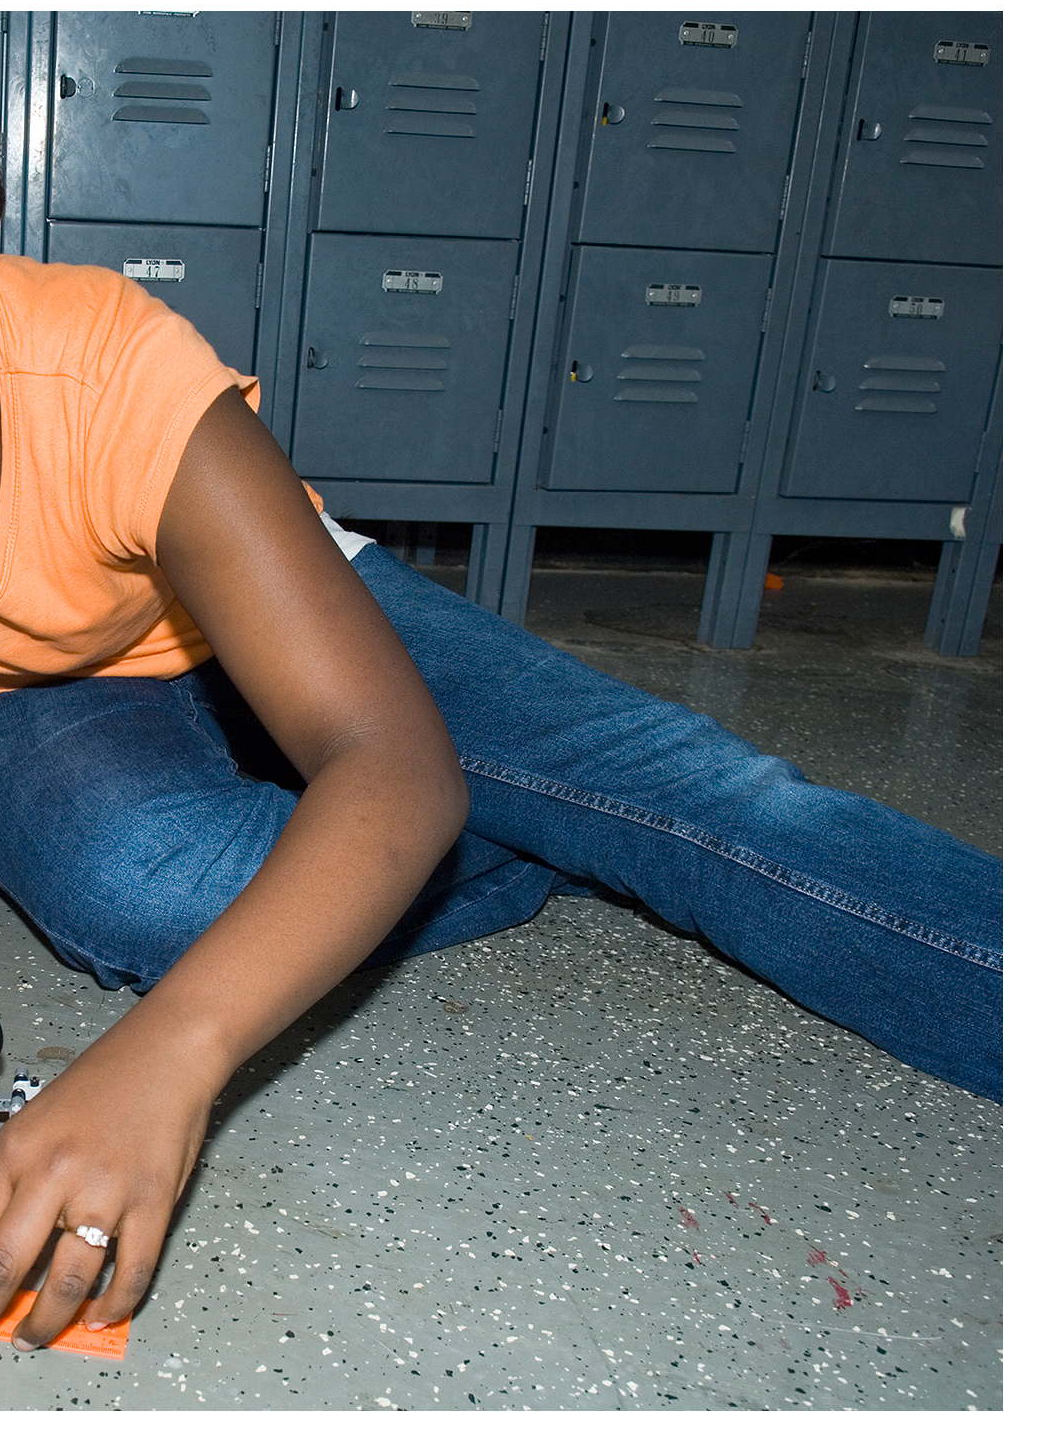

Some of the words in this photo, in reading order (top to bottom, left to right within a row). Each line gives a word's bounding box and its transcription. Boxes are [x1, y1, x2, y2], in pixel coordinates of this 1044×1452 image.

[433, 12, 449, 25] 39
[700, 29, 715, 43] 40
[954, 49, 968, 62] 41
[145, 265, 160, 278] 47
[405, 277, 419, 289] 48
